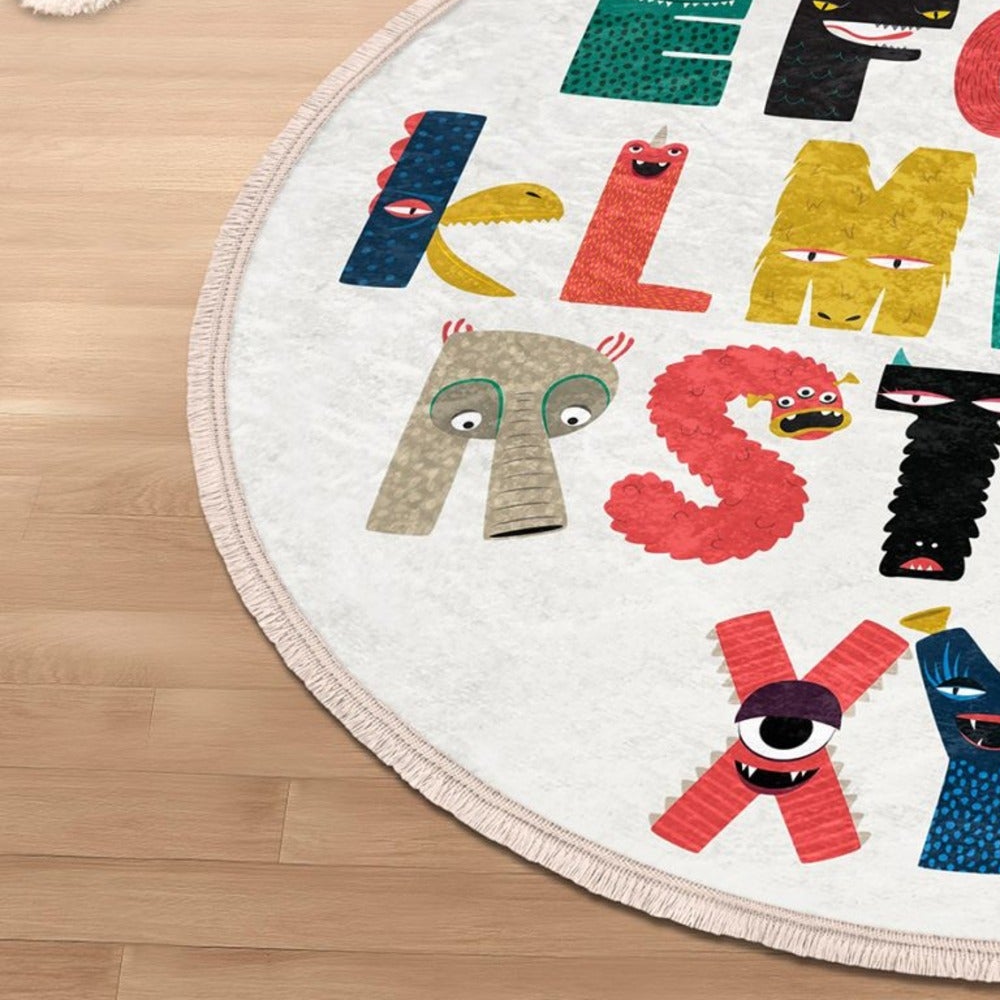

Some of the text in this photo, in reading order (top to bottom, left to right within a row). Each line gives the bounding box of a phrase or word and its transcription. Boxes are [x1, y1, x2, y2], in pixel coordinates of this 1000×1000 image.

[559, 125, 713, 313] L
[745, 139, 978, 338] M
[365, 318, 635, 541] R
[603, 344, 860, 565] S
[649, 610, 912, 864] X
